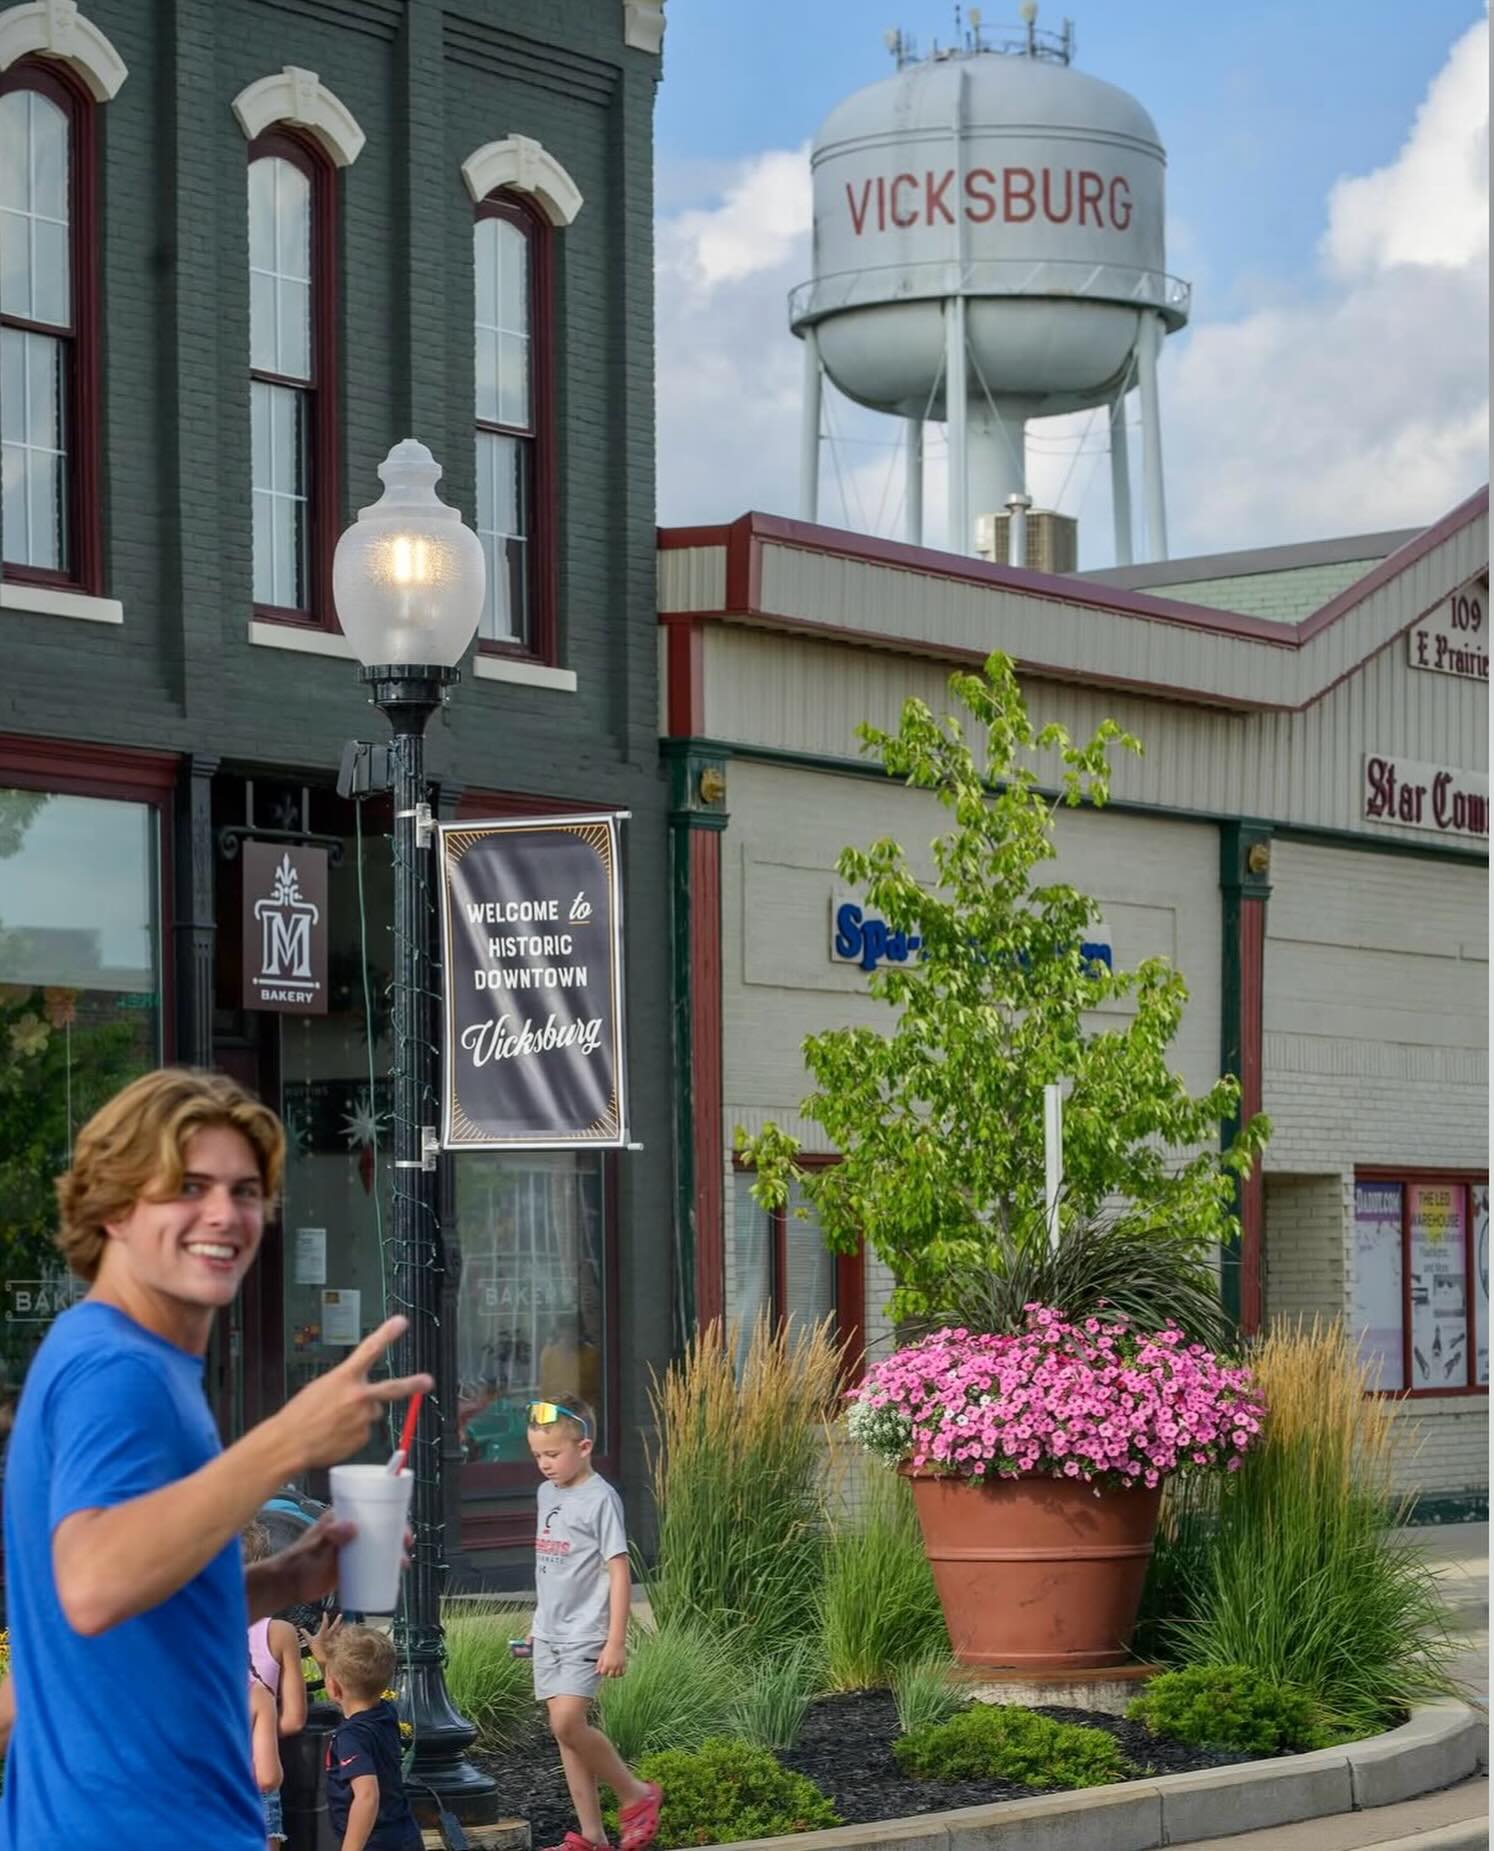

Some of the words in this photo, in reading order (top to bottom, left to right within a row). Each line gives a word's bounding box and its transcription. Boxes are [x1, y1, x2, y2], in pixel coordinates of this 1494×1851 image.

[846, 168, 1133, 236] VICKSBURG
[1451, 595, 1482, 632] 109
[1417, 630, 1429, 666] E
[1366, 757, 1427, 824] Star
[1432, 770, 1489, 833] Com
[467, 900, 559, 924] WELCOME
[569, 891, 593, 920] to
[261, 910, 312, 977] M
[488, 934, 573, 958] HISTORIC
[260, 988, 313, 1004] BAKERY
[474, 966, 588, 990] DOWNTOWN
[461, 1013, 603, 1068] Vicksburg
